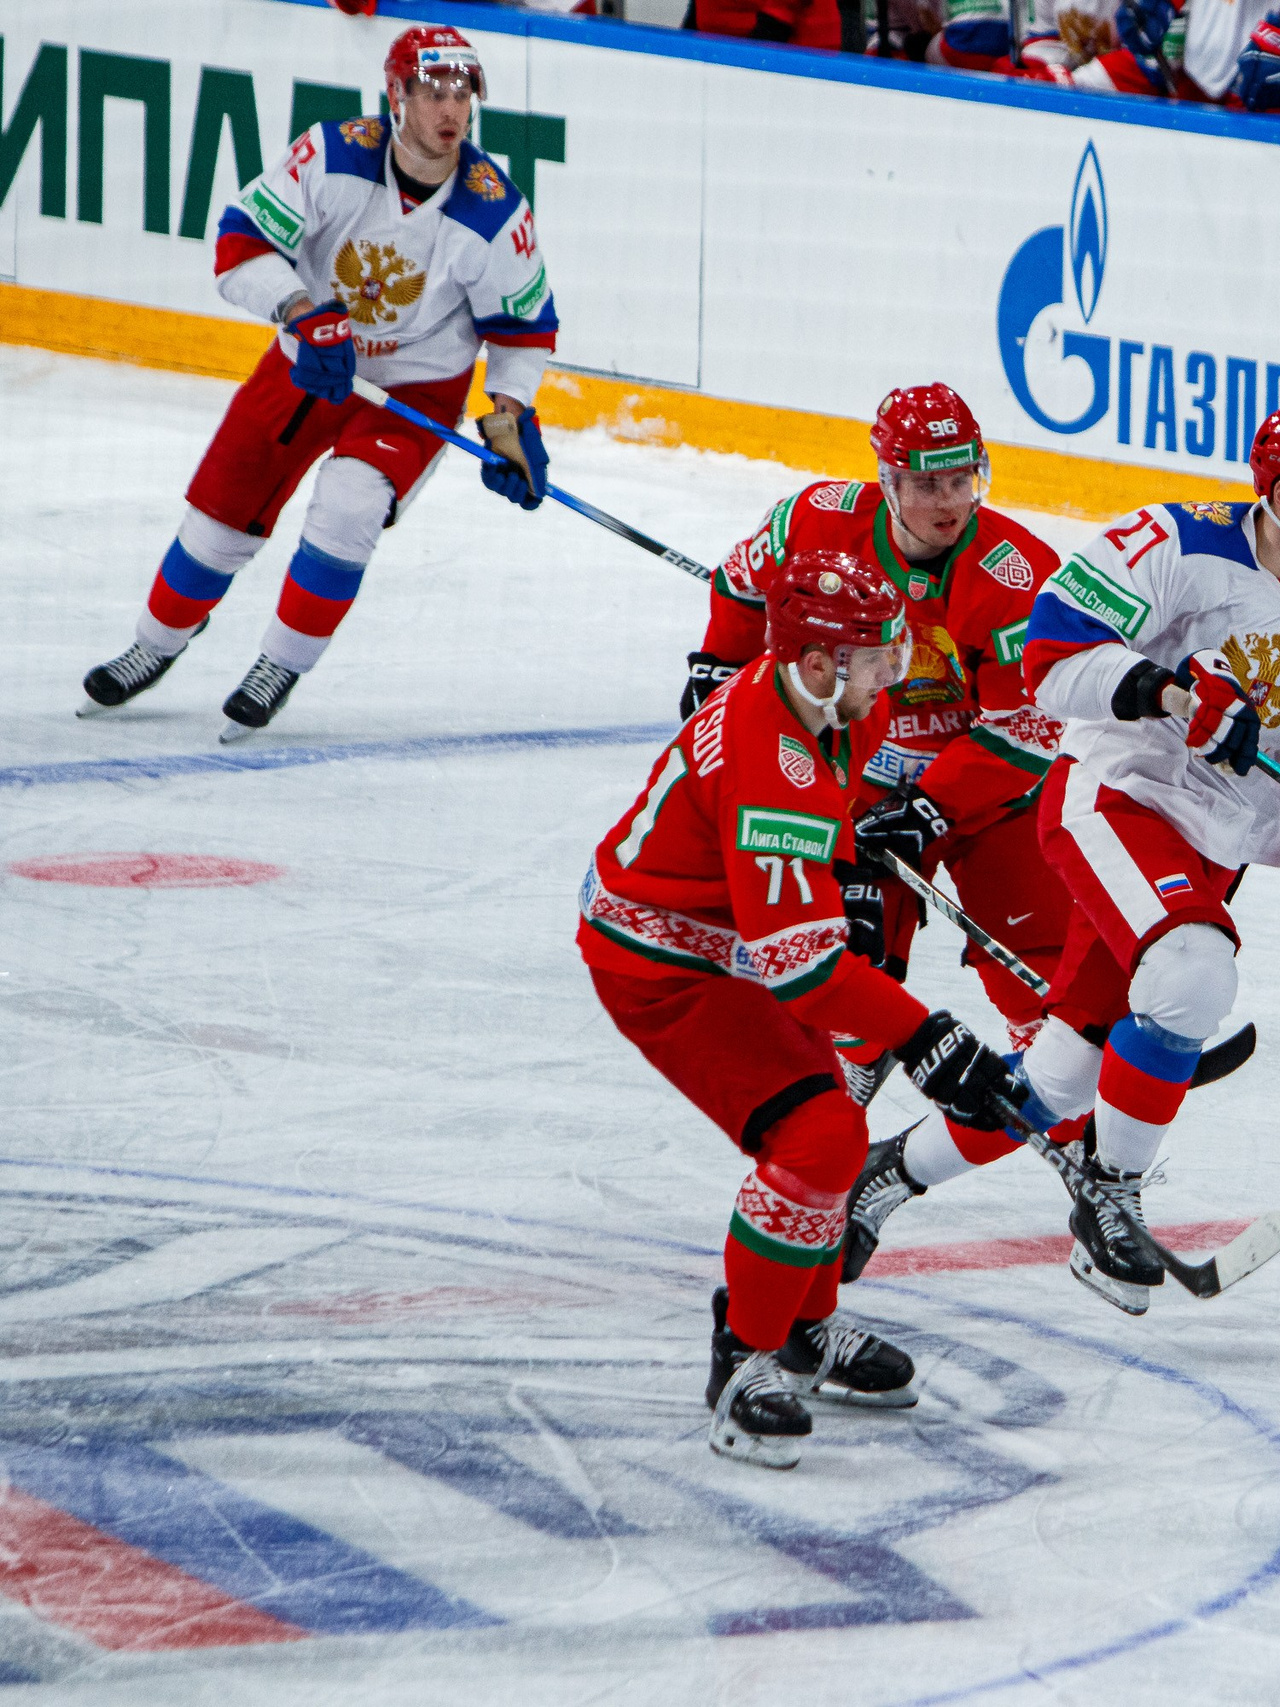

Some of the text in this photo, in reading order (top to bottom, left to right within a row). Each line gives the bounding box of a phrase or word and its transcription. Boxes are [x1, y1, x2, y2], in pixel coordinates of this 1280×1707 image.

[928, 418, 958, 438] 96
[1104, 509, 1169, 569] 27
[755, 855, 814, 905] 71
